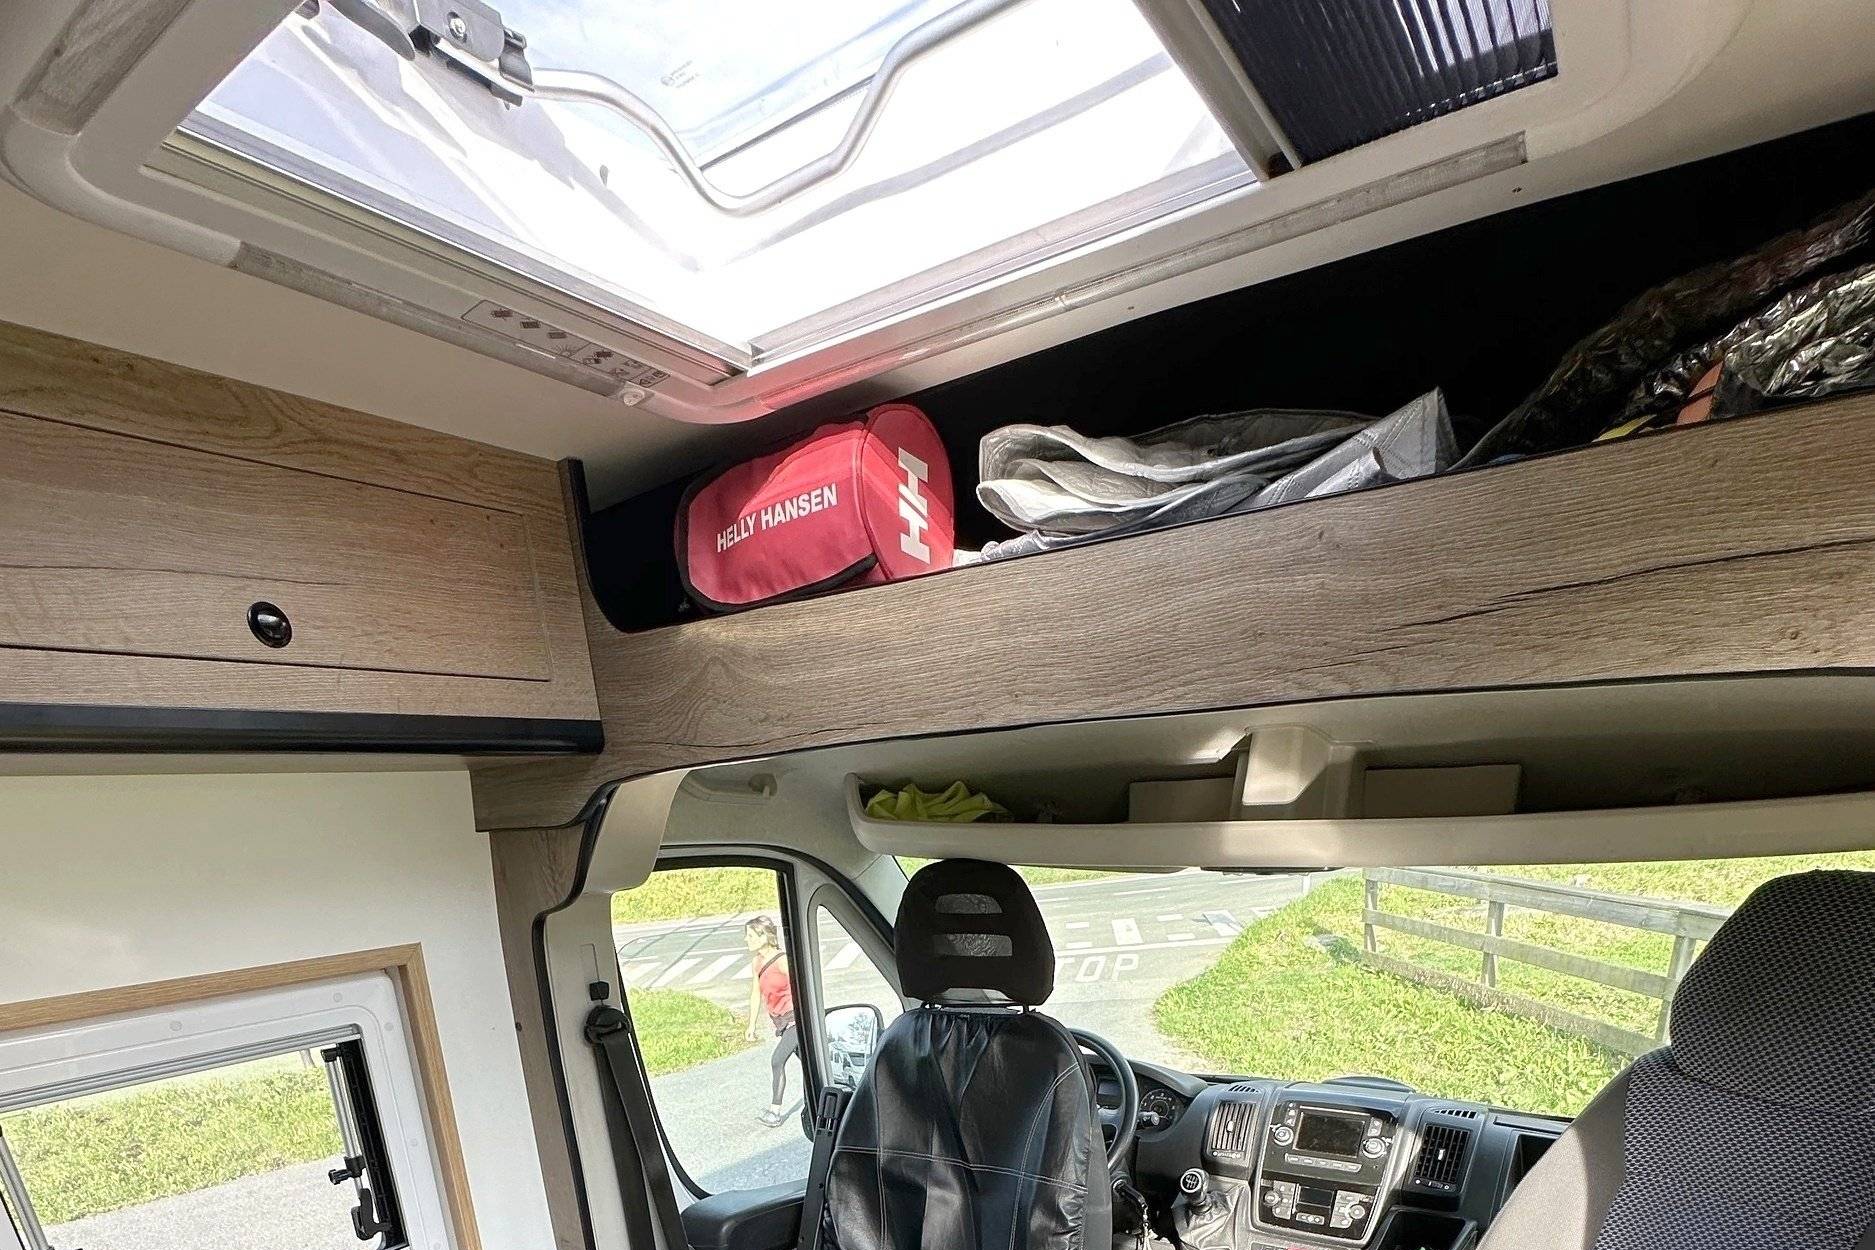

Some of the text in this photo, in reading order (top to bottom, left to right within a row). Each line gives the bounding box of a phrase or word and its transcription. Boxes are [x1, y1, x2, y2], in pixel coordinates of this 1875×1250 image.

[716, 483, 838, 553] HELLY HANSEN
[1053, 953, 1140, 982] TOP
